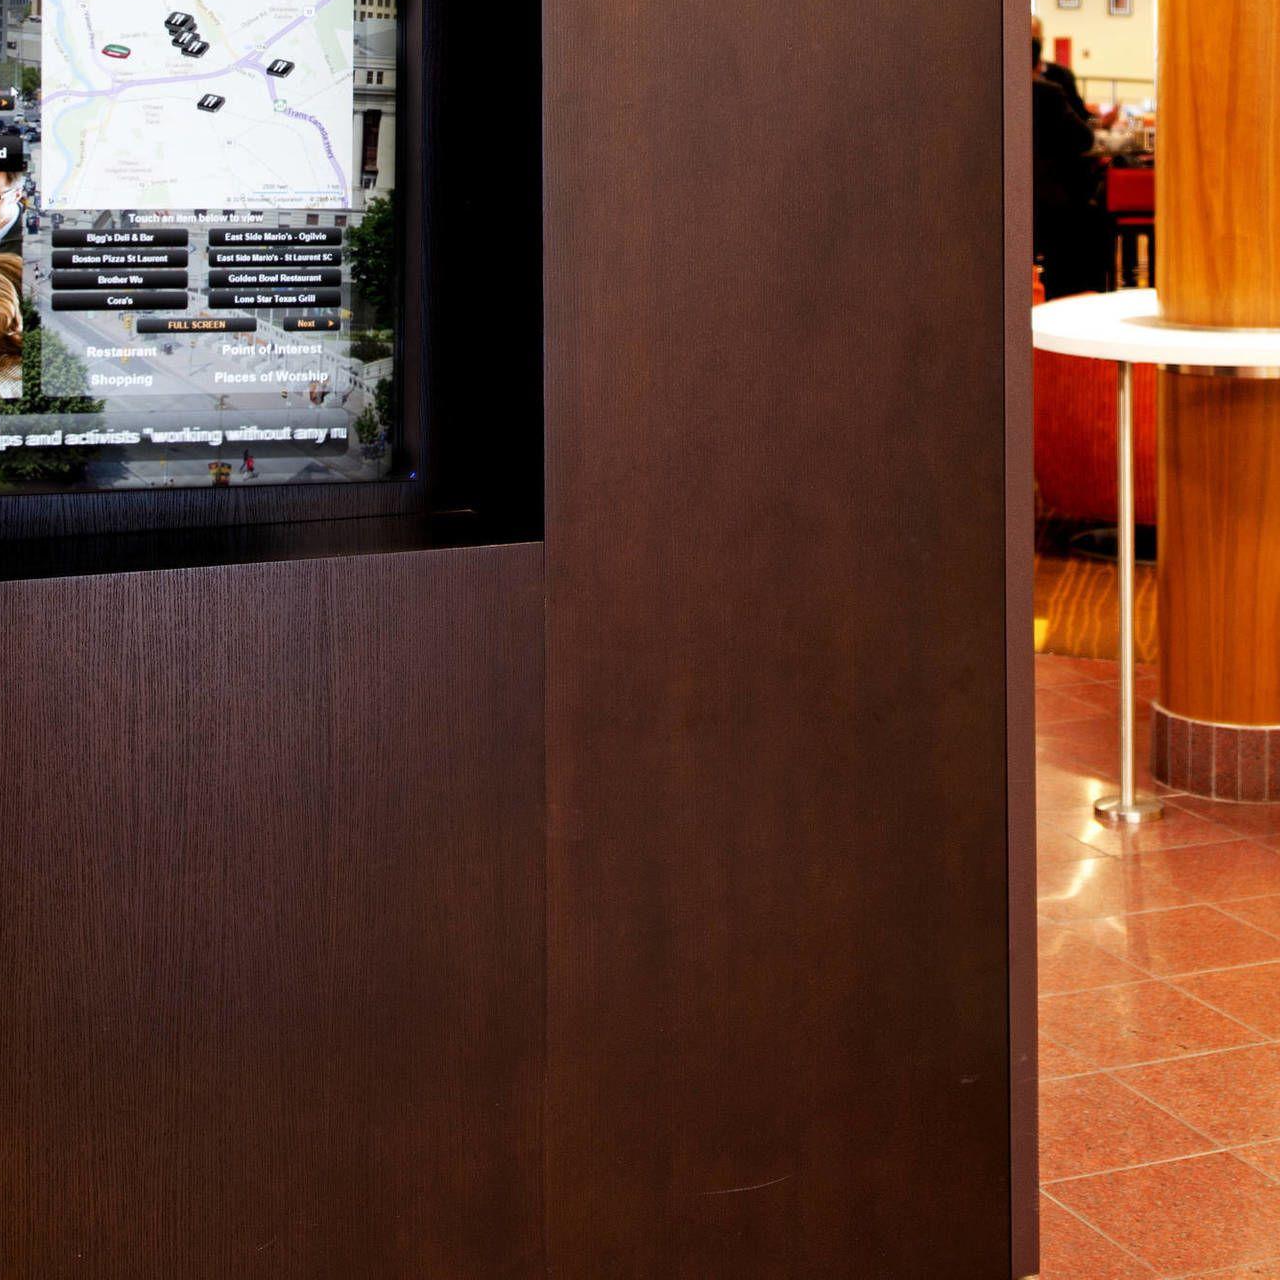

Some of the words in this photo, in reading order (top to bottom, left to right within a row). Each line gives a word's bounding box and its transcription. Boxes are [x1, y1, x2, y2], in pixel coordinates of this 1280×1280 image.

[128, 214, 159, 223] Touch
[225, 233, 243, 241] East
[245, 233, 262, 241] Side
[72, 255, 100, 263] Boston
[102, 255, 125, 263] Pizza
[228, 274, 257, 283] Golden
[280, 274, 322, 282] Restaurant
[257, 295, 273, 303] Star
[168, 321, 190, 329] FULL
[192, 320, 226, 329] SCREEN
[87, 346, 157, 358] Restaurant
[222, 345, 256, 356] Point
[258, 344, 272, 355] of
[275, 344, 322, 354] Interest
[91, 374, 153, 387] Shopping
[215, 372, 256, 384] Places
[260, 371, 274, 383] of
[276, 371, 328, 384] Worship
[25, 430, 61, 446] and
[64, 428, 140, 445] activists
[225, 426, 291, 441] without
[294, 427, 328, 443] any
